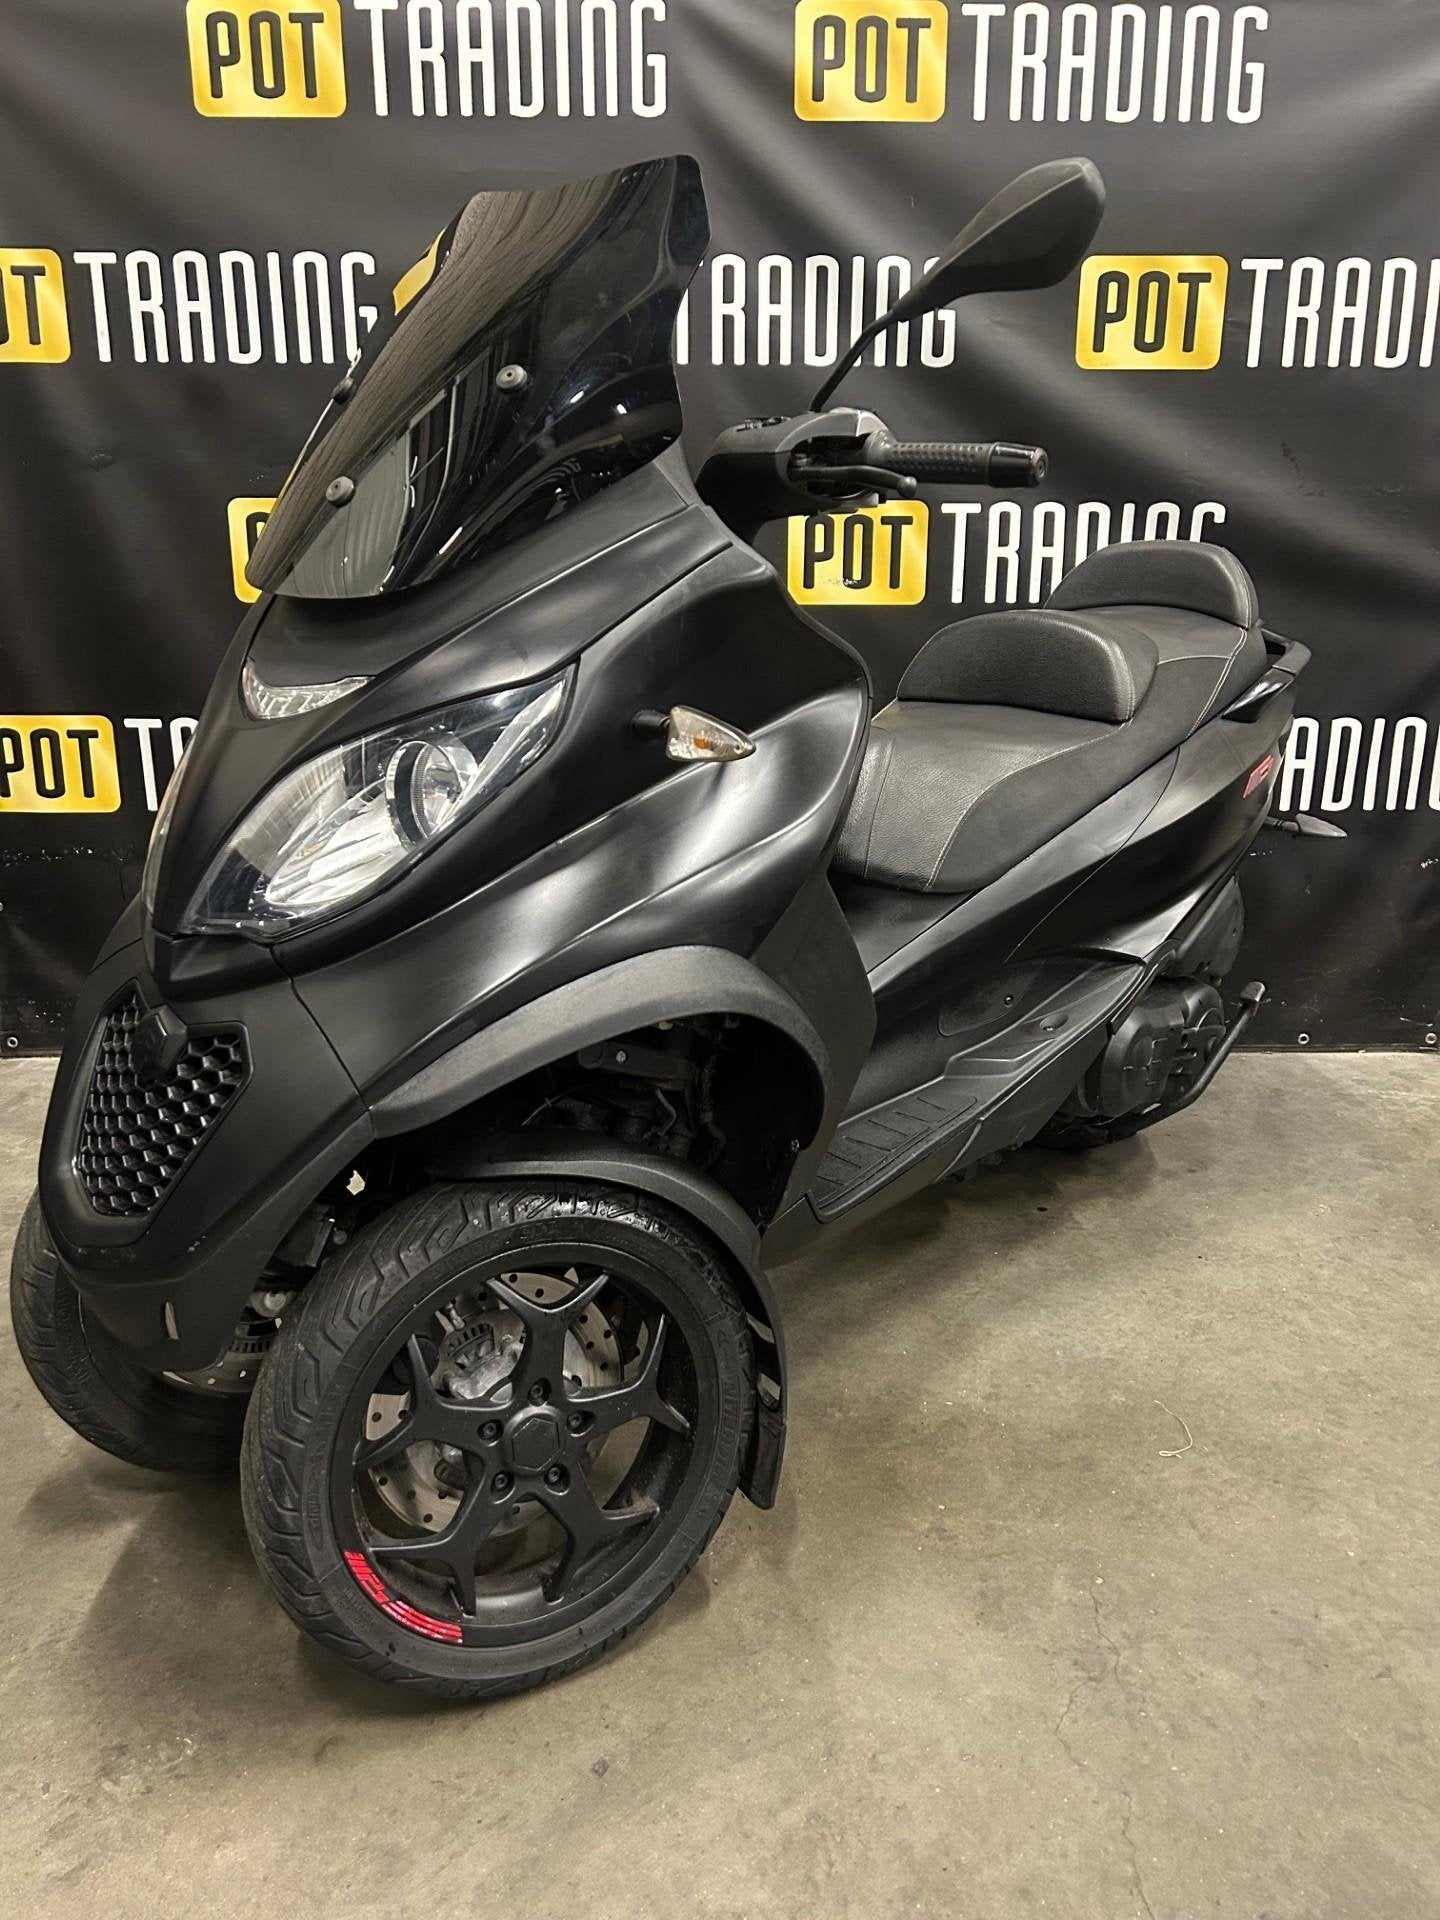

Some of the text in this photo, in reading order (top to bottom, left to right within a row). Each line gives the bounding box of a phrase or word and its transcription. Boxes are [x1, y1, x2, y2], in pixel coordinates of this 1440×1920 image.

[205, 0, 668, 118] POT TRADING
[811, 2, 1269, 124] POT TRADING
[1092, 256, 1440, 368] POT TRADI
[802, 513, 913, 589] POT
[0, 728, 99, 799] POT
[1279, 717, 1440, 812] ADIN
